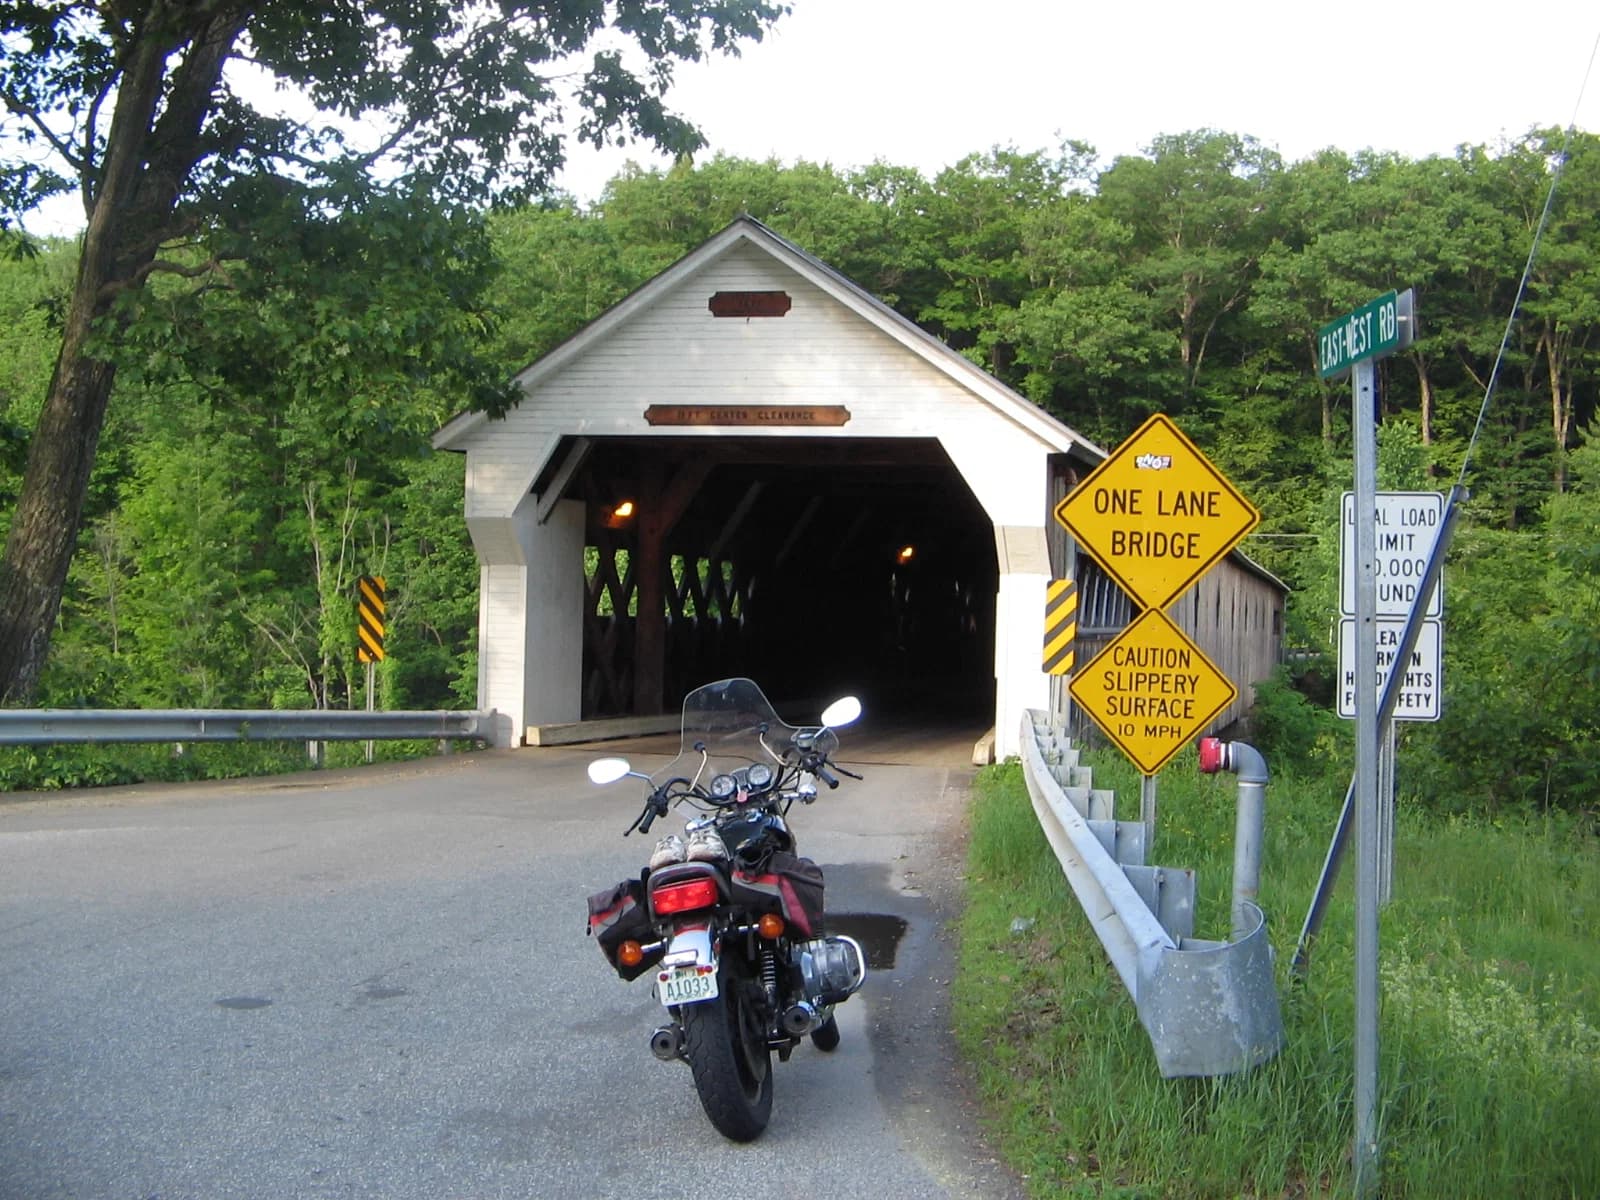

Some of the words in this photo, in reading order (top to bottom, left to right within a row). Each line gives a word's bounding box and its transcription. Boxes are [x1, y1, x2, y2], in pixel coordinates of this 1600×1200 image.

[1321, 311, 1372, 371] EAST-WEST
[1379, 302, 1395, 344] RD
[710, 410, 748, 420] CENTER
[758, 410, 816, 420] CLEARANCE
[1094, 488, 1142, 515] ONE
[1157, 490, 1221, 517] LANE
[1348, 508, 1389, 526] LAL
[1401, 508, 1436, 527] LOAD
[1111, 530, 1201, 559] BRIDGE
[1376, 533, 1415, 551] IMIT
[1113, 646, 1191, 669] CAUTION
[1103, 671, 1200, 695] SLIPPERY
[1106, 695, 1195, 719] SURFACE
[1398, 693, 1432, 708] FETY
[1118, 723, 1135, 737] 10
[1144, 724, 1182, 738] MPH
[667, 976, 710, 1001] A1033
